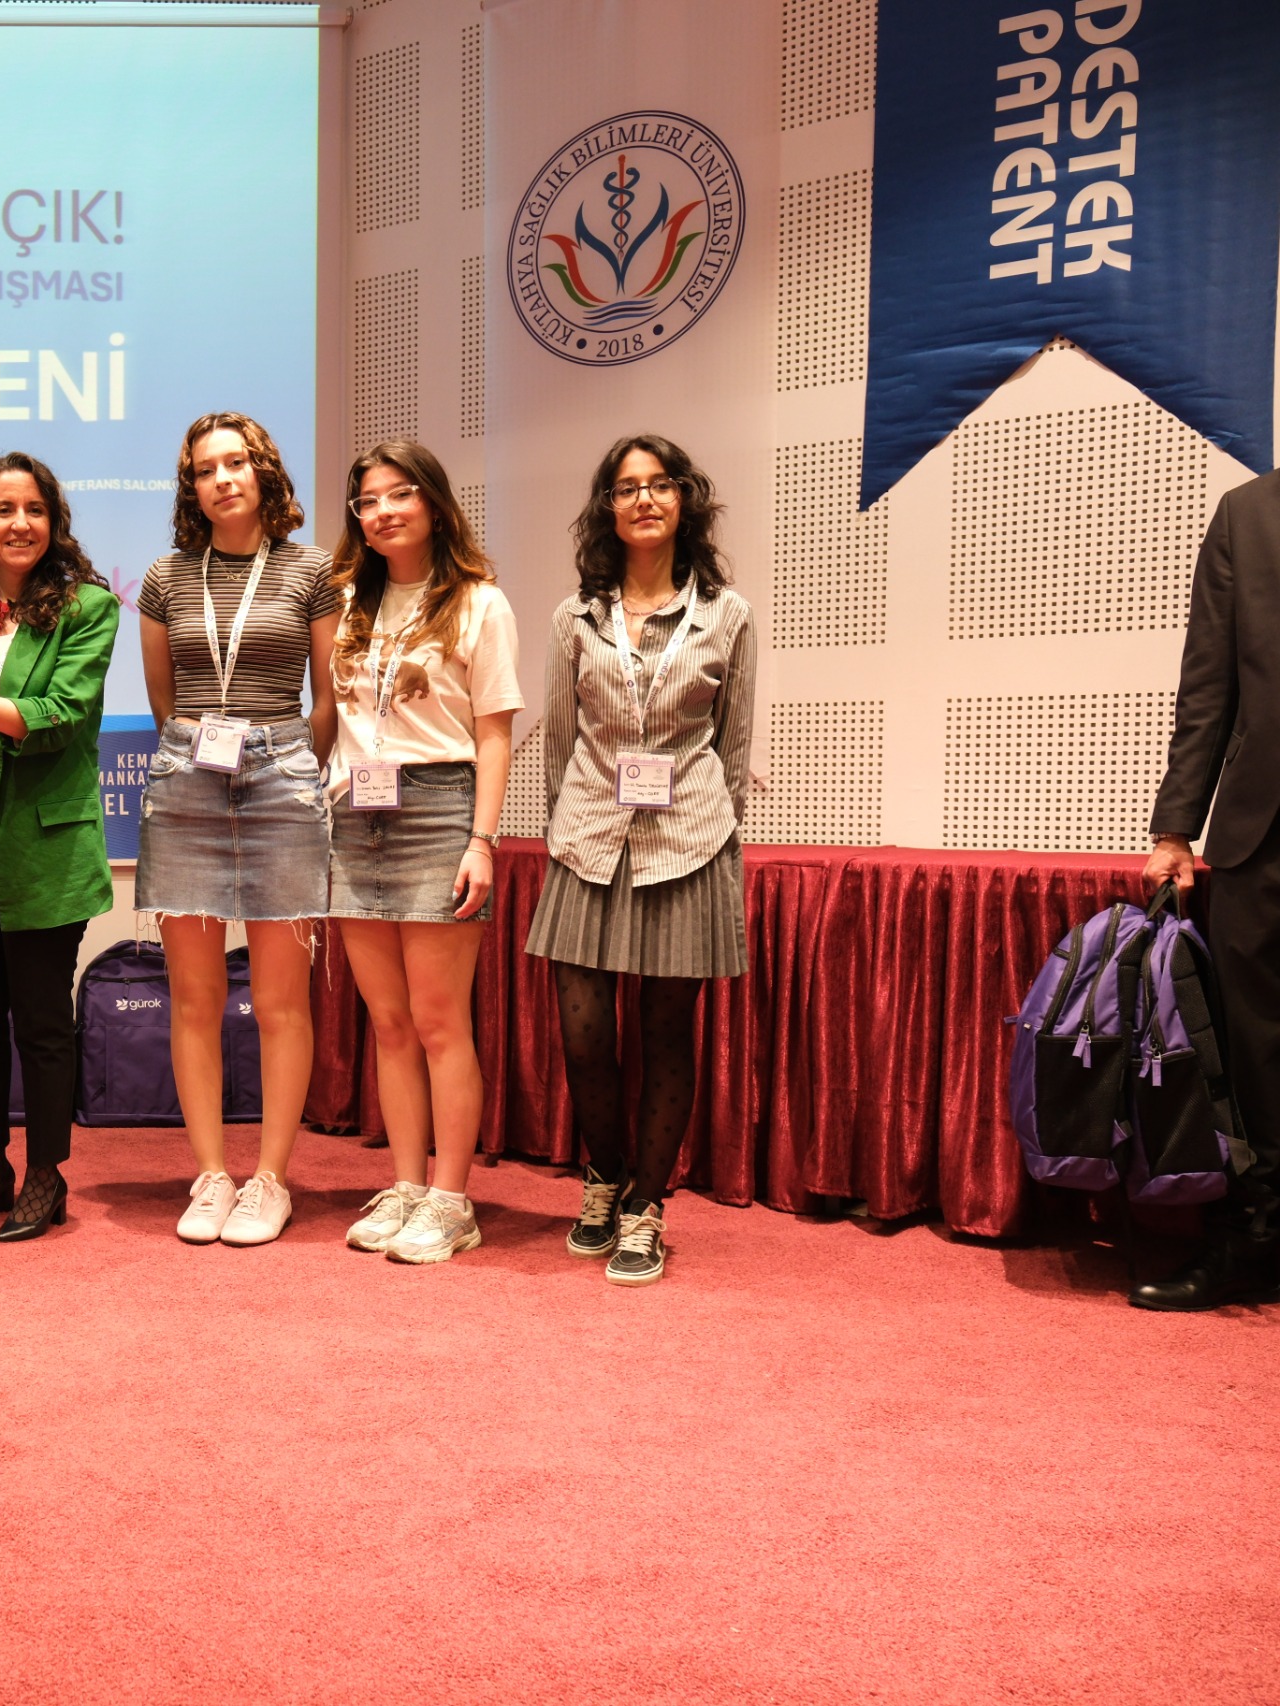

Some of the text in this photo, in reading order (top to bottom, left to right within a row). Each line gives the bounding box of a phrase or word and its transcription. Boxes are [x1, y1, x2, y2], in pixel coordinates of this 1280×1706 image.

[989, 8, 1064, 285] PATENT
[1063, 0, 1142, 278] DESTEK
[1, 188, 125, 258] ÇIK!
[517, 123, 733, 346] KÜTAHYA SAĞLIK BİLİMLERİ ÜNİVERSİTESİ
[596, 333, 645, 358] 2018
[129, 998, 162, 1011] gürok
